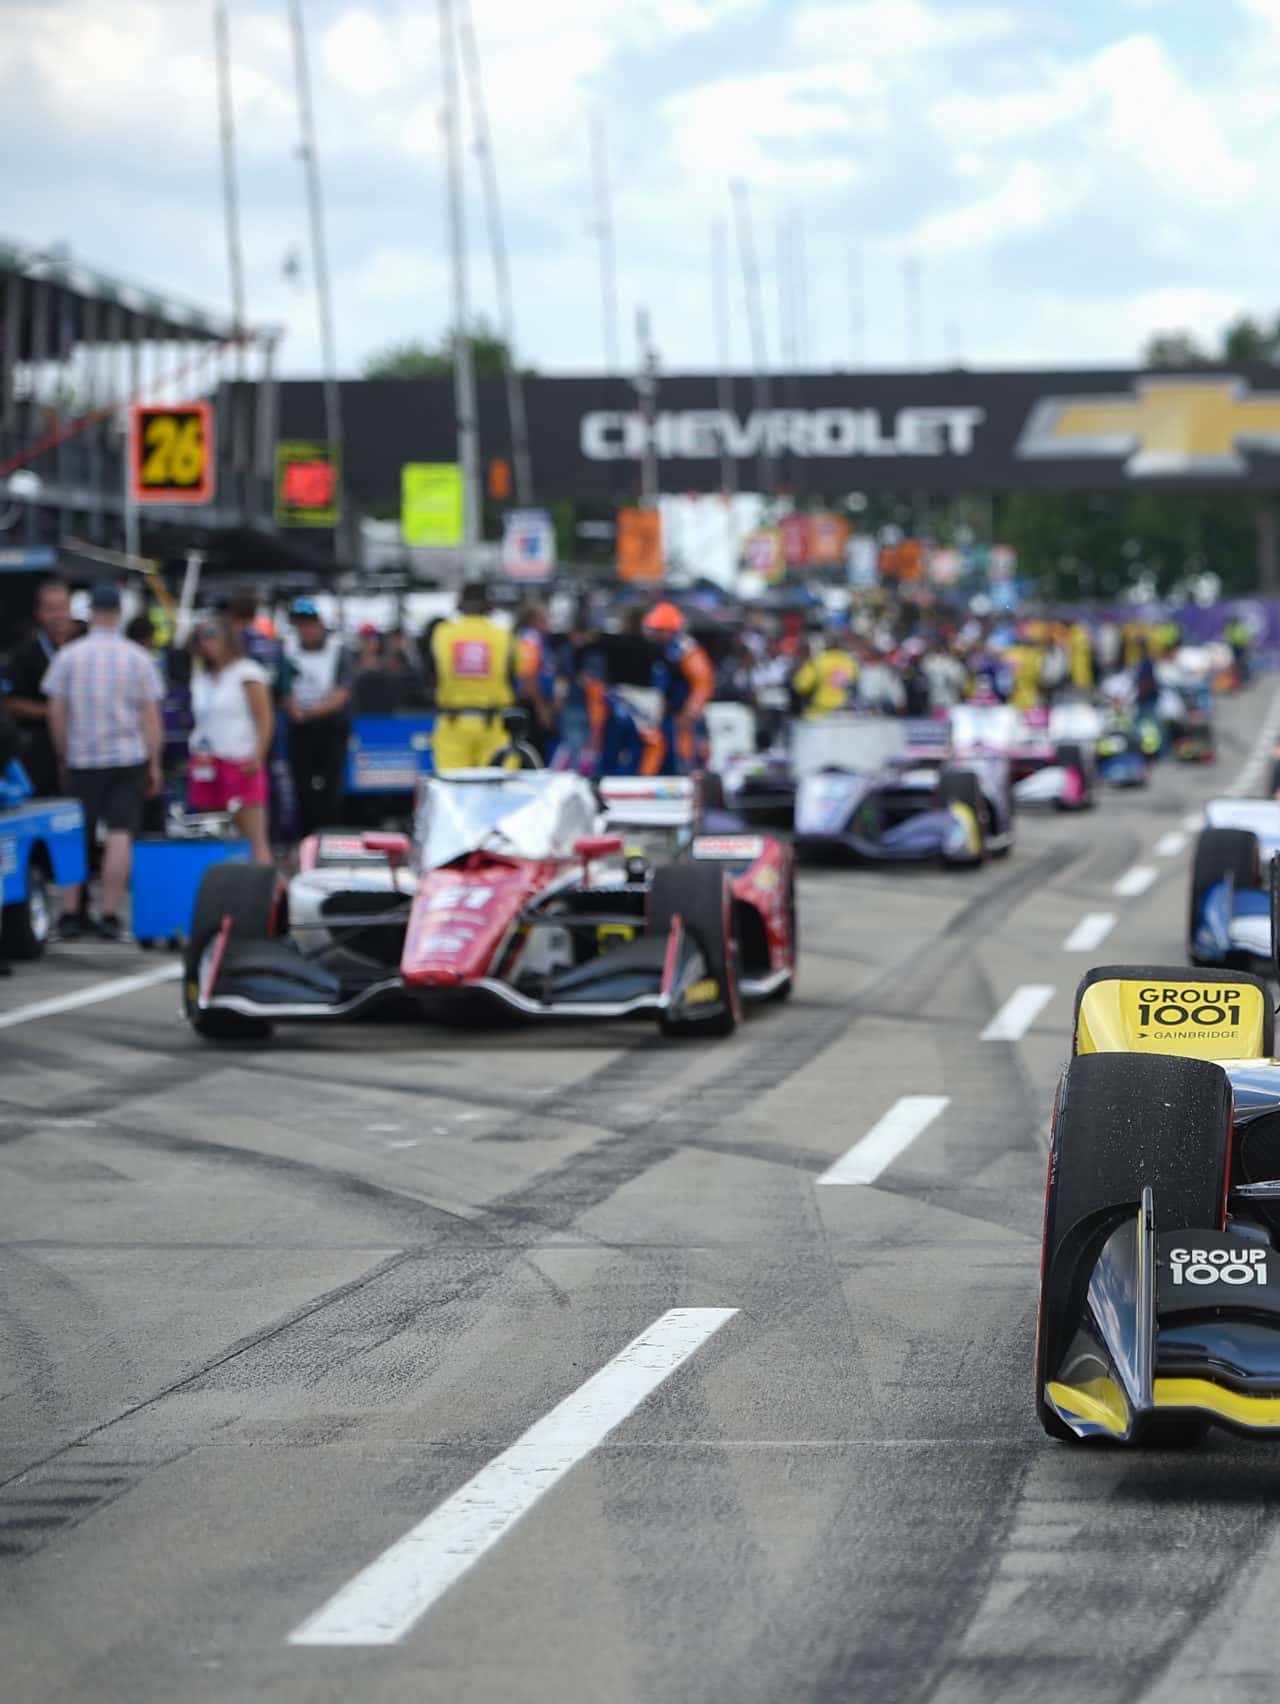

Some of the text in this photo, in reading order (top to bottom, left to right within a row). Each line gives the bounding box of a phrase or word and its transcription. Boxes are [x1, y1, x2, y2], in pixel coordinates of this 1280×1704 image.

[580, 406, 985, 459] CHEVROLET
[144, 416, 203, 486] 26
[1139, 988, 1241, 1004] GROUP
[1138, 1004, 1240, 1026] 1001
[1154, 1031, 1239, 1040] GAINBRIDGE
[1169, 1248, 1267, 1264] GROUP
[1170, 1263, 1267, 1285] 1001
